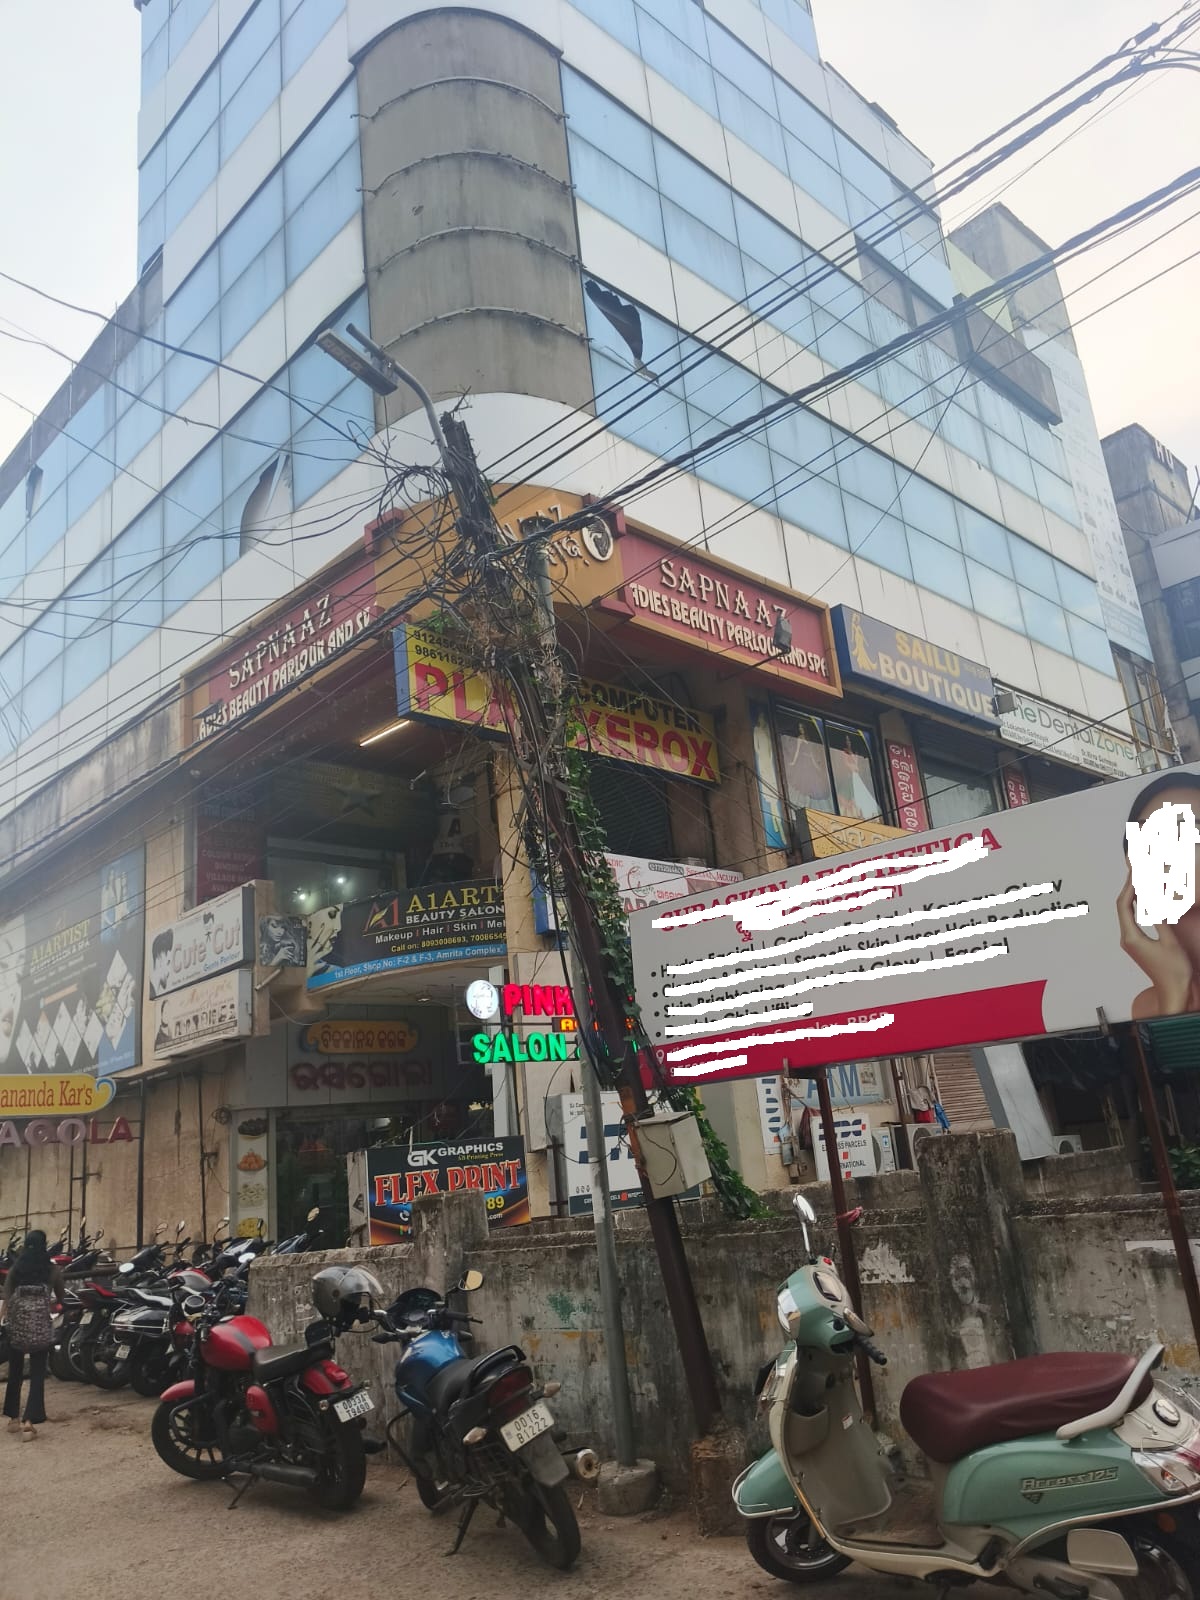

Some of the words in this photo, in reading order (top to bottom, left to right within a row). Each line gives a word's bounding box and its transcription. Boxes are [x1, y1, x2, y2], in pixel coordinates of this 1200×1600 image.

[671, 599, 725, 640] BEAUTY
[896, 631, 960, 678] SAILU
[229, 674, 271, 721] BEAUTY
[272, 641, 326, 692] PARLOUR
[878, 652, 997, 720] BOUTIQUE
[405, 909, 454, 925] BEAUTY
[459, 904, 505, 918] SALON
[171, 940, 206, 974] Cute
[211, 917, 240, 956] Cut
[375, 930, 414, 944] Makeup
[422, 926, 444, 936] Hair
[453, 921, 478, 932] Skin
[436, 950, 463, 961] Amrita
[503, 983, 573, 1016] PINK
[472, 1031, 568, 1064] SALON
[59, 1080, 93, 1107] Kar's
[408, 1149, 438, 1167] GK
[437, 1142, 504, 1157] GRAPHICS
[374, 1168, 440, 1207] FLEX
[447, 1158, 521, 1194] PRINT
